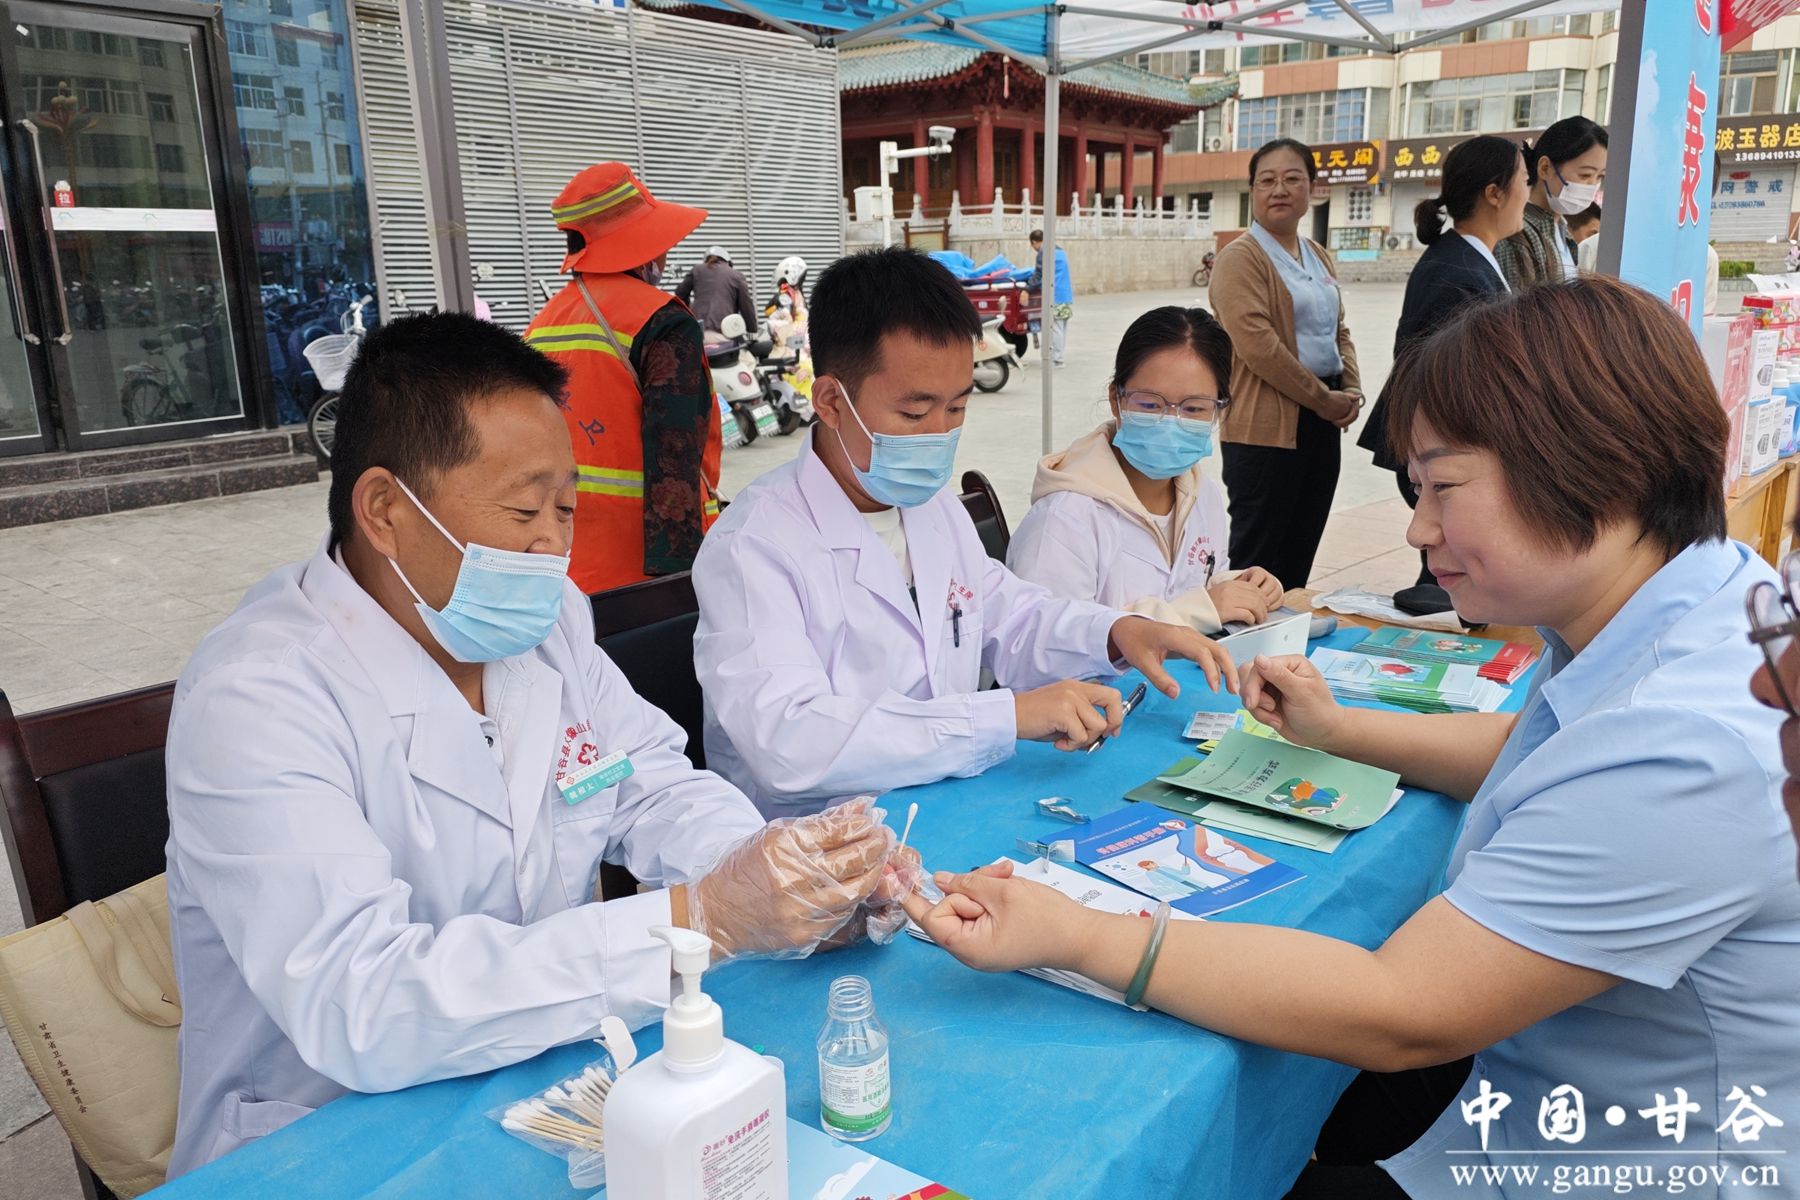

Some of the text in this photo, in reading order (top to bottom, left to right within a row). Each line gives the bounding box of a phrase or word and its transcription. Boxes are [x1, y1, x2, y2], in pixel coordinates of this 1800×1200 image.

[58, 193, 72, 204] 拉
[39, 1022, 88, 1114] 甘肃省卫生健康委员会
